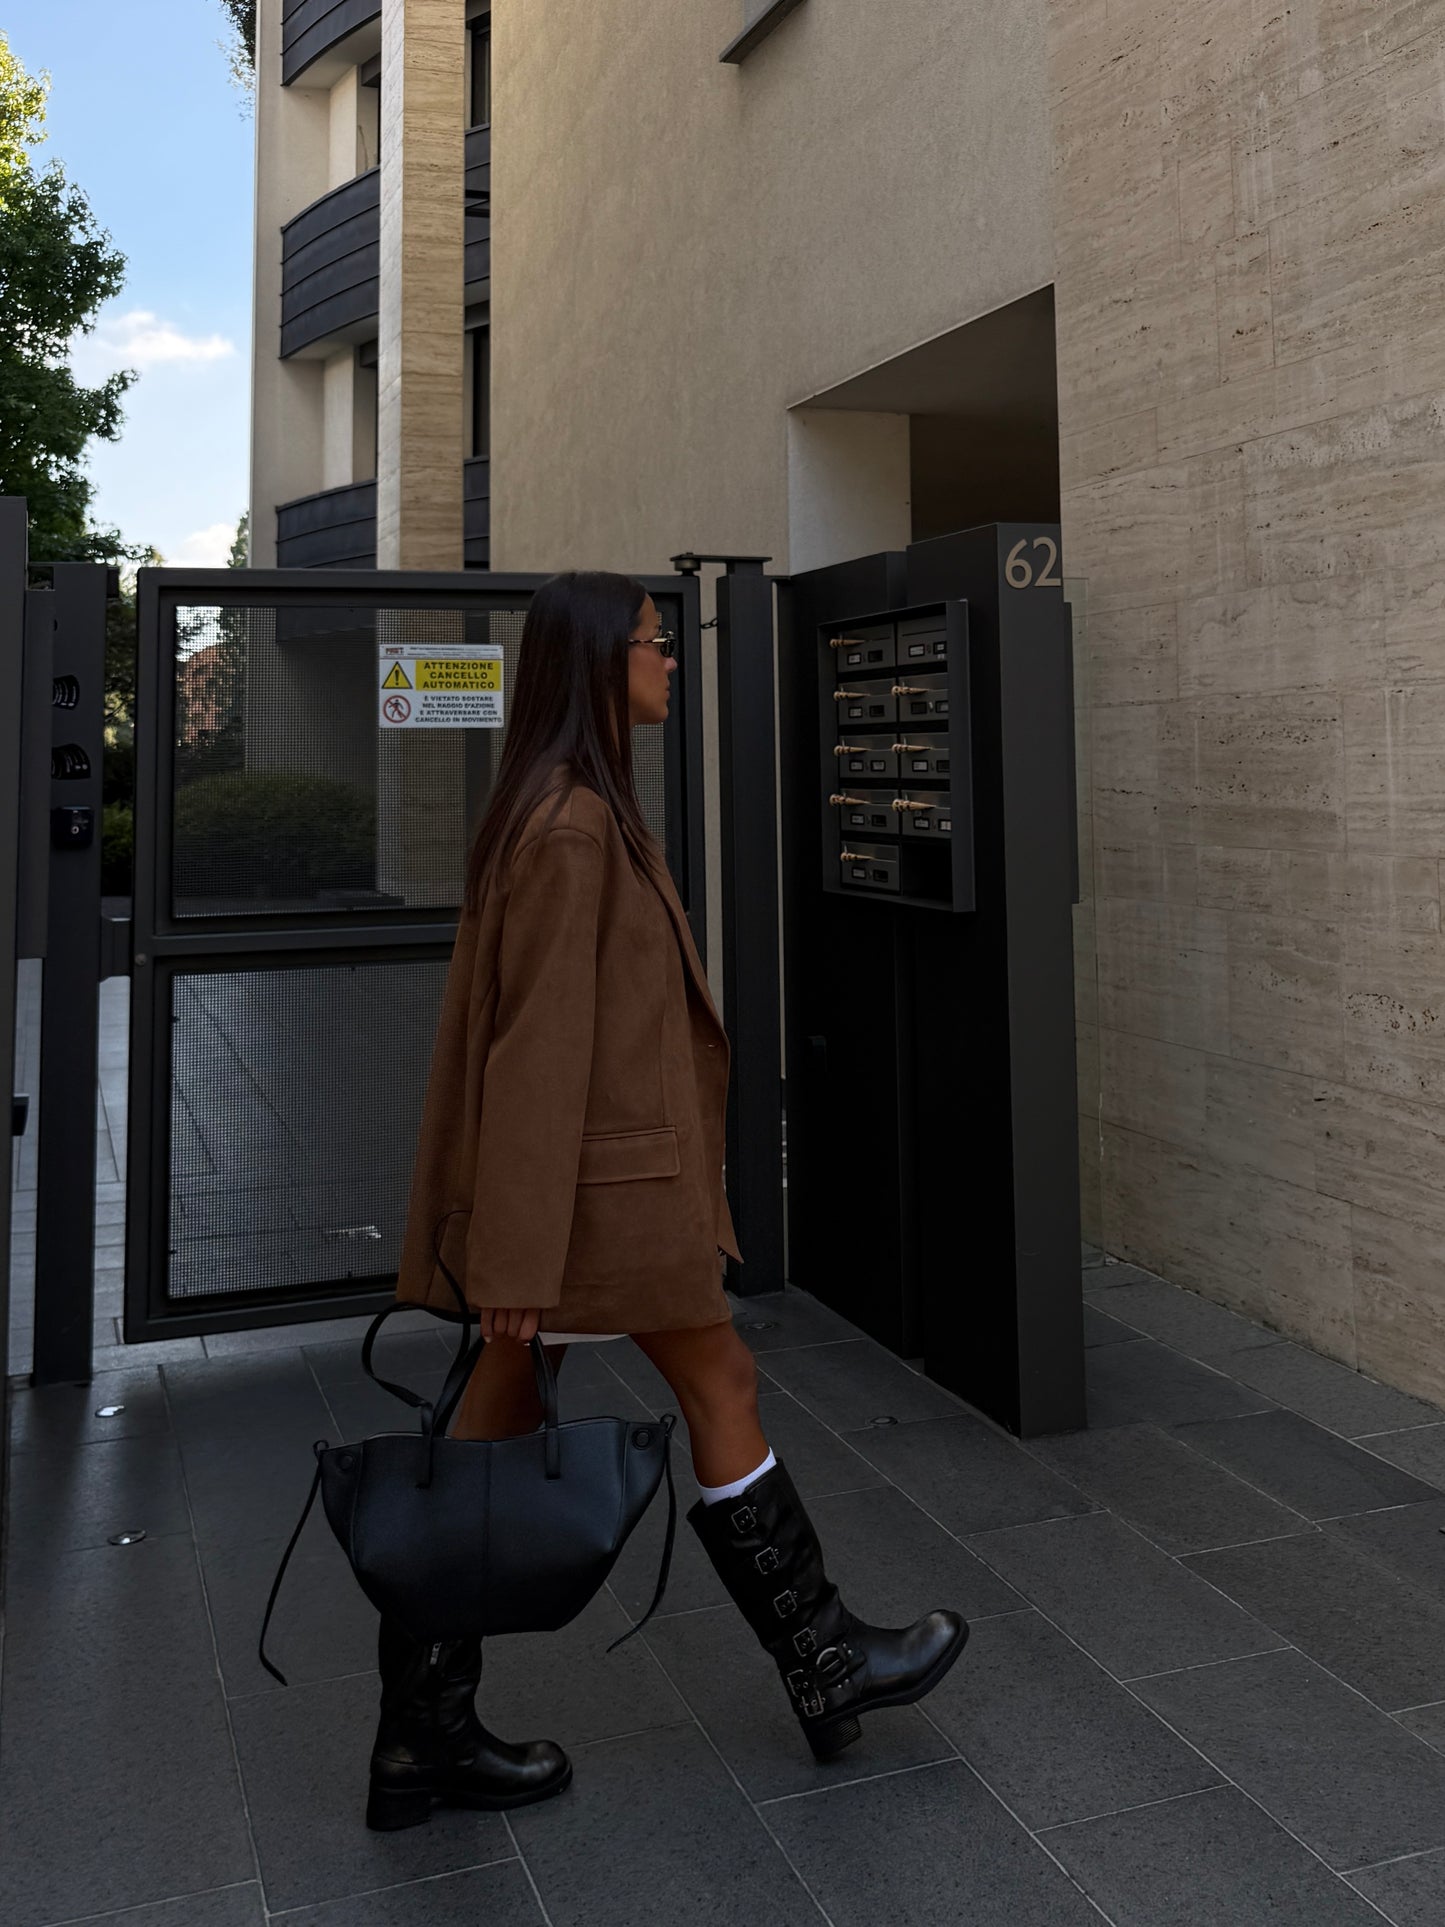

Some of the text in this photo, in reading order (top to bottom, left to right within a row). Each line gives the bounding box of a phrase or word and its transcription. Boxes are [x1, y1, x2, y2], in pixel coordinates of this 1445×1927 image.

[1005, 536, 1062, 589] 62
[424, 662, 493, 670] ATTENZIONE
[430, 672, 488, 680] CANCELLO
[423, 681, 495, 689] AUTOMATICO
